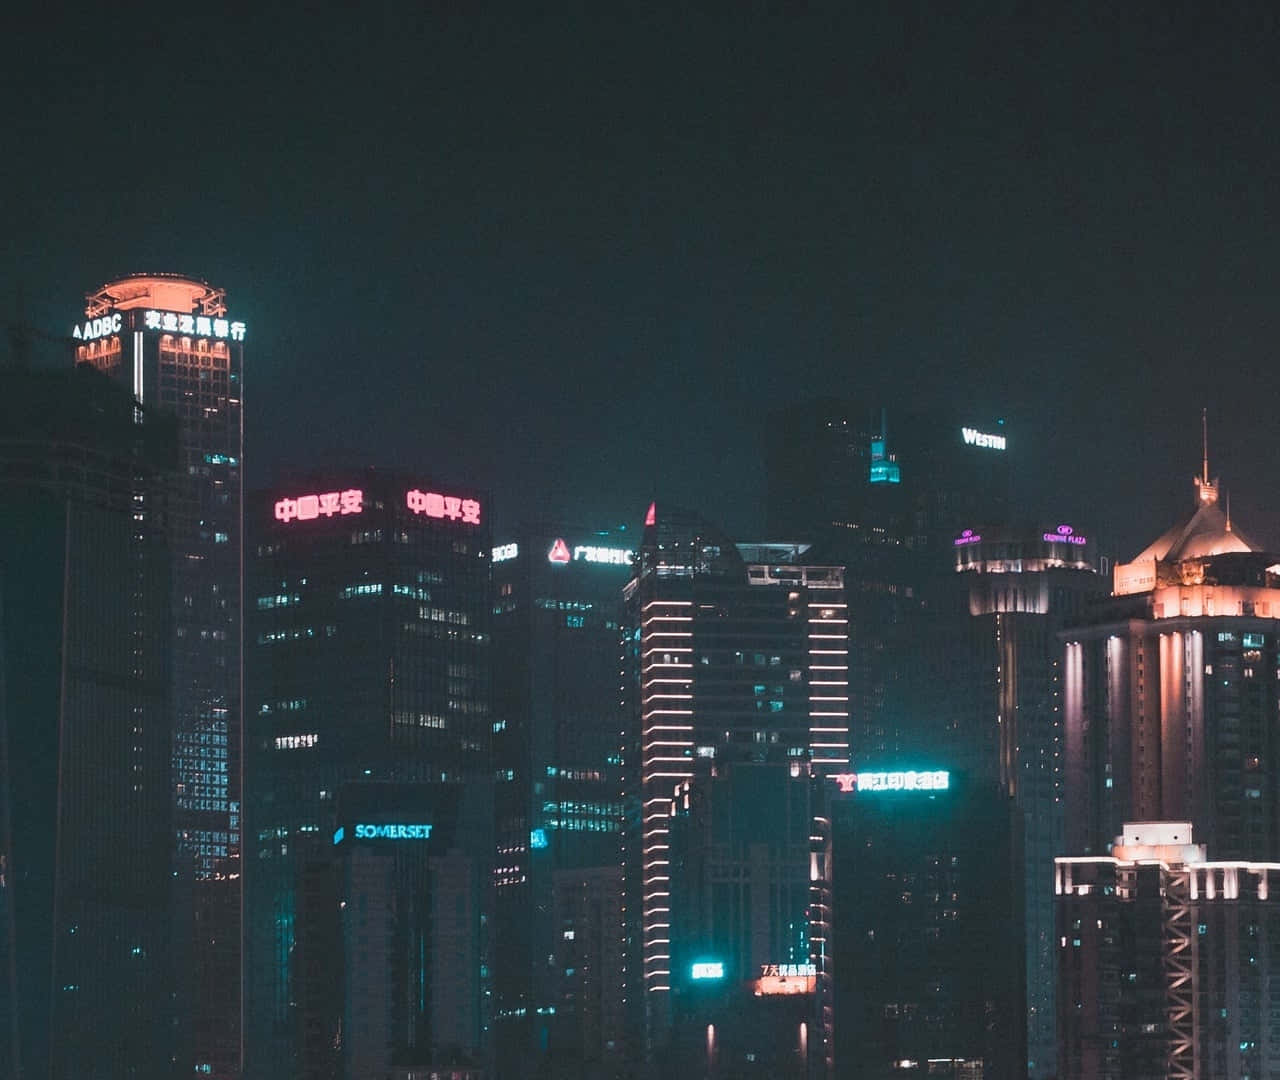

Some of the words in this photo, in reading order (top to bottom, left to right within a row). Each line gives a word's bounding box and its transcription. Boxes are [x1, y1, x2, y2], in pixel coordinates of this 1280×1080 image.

[83, 313, 122, 341] ADBC
[145, 310, 247, 341] 农业发展银行
[275, 489, 363, 523] 中国平安
[407, 489, 481, 525] 中国平安
[354, 824, 433, 839] SOMERSET
